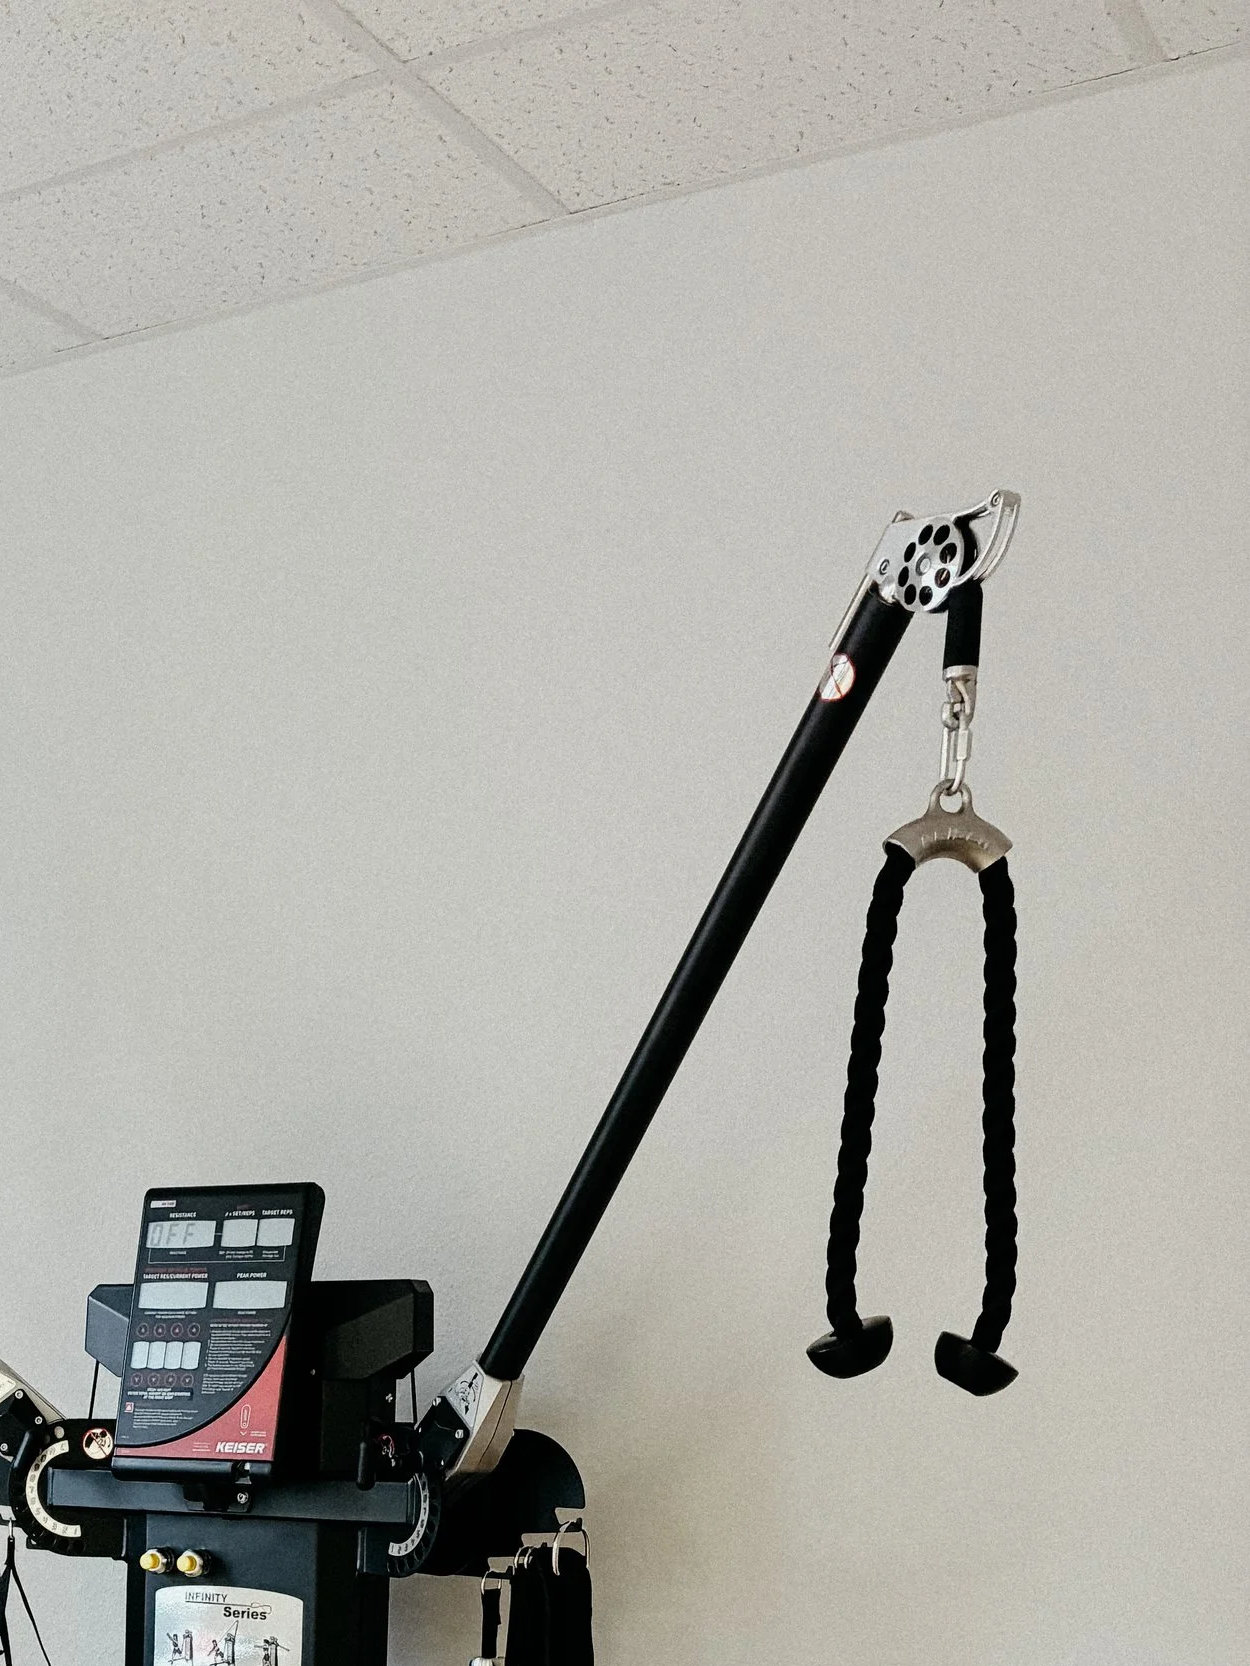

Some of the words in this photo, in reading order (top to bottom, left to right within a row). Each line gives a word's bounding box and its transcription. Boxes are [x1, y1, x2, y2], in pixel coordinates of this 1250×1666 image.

[150, 1223, 195, 1247] OFF
[215, 1441, 265, 1454] KEISER
[185, 1591, 228, 1603] INFINITY
[223, 1606, 267, 1621] Series
